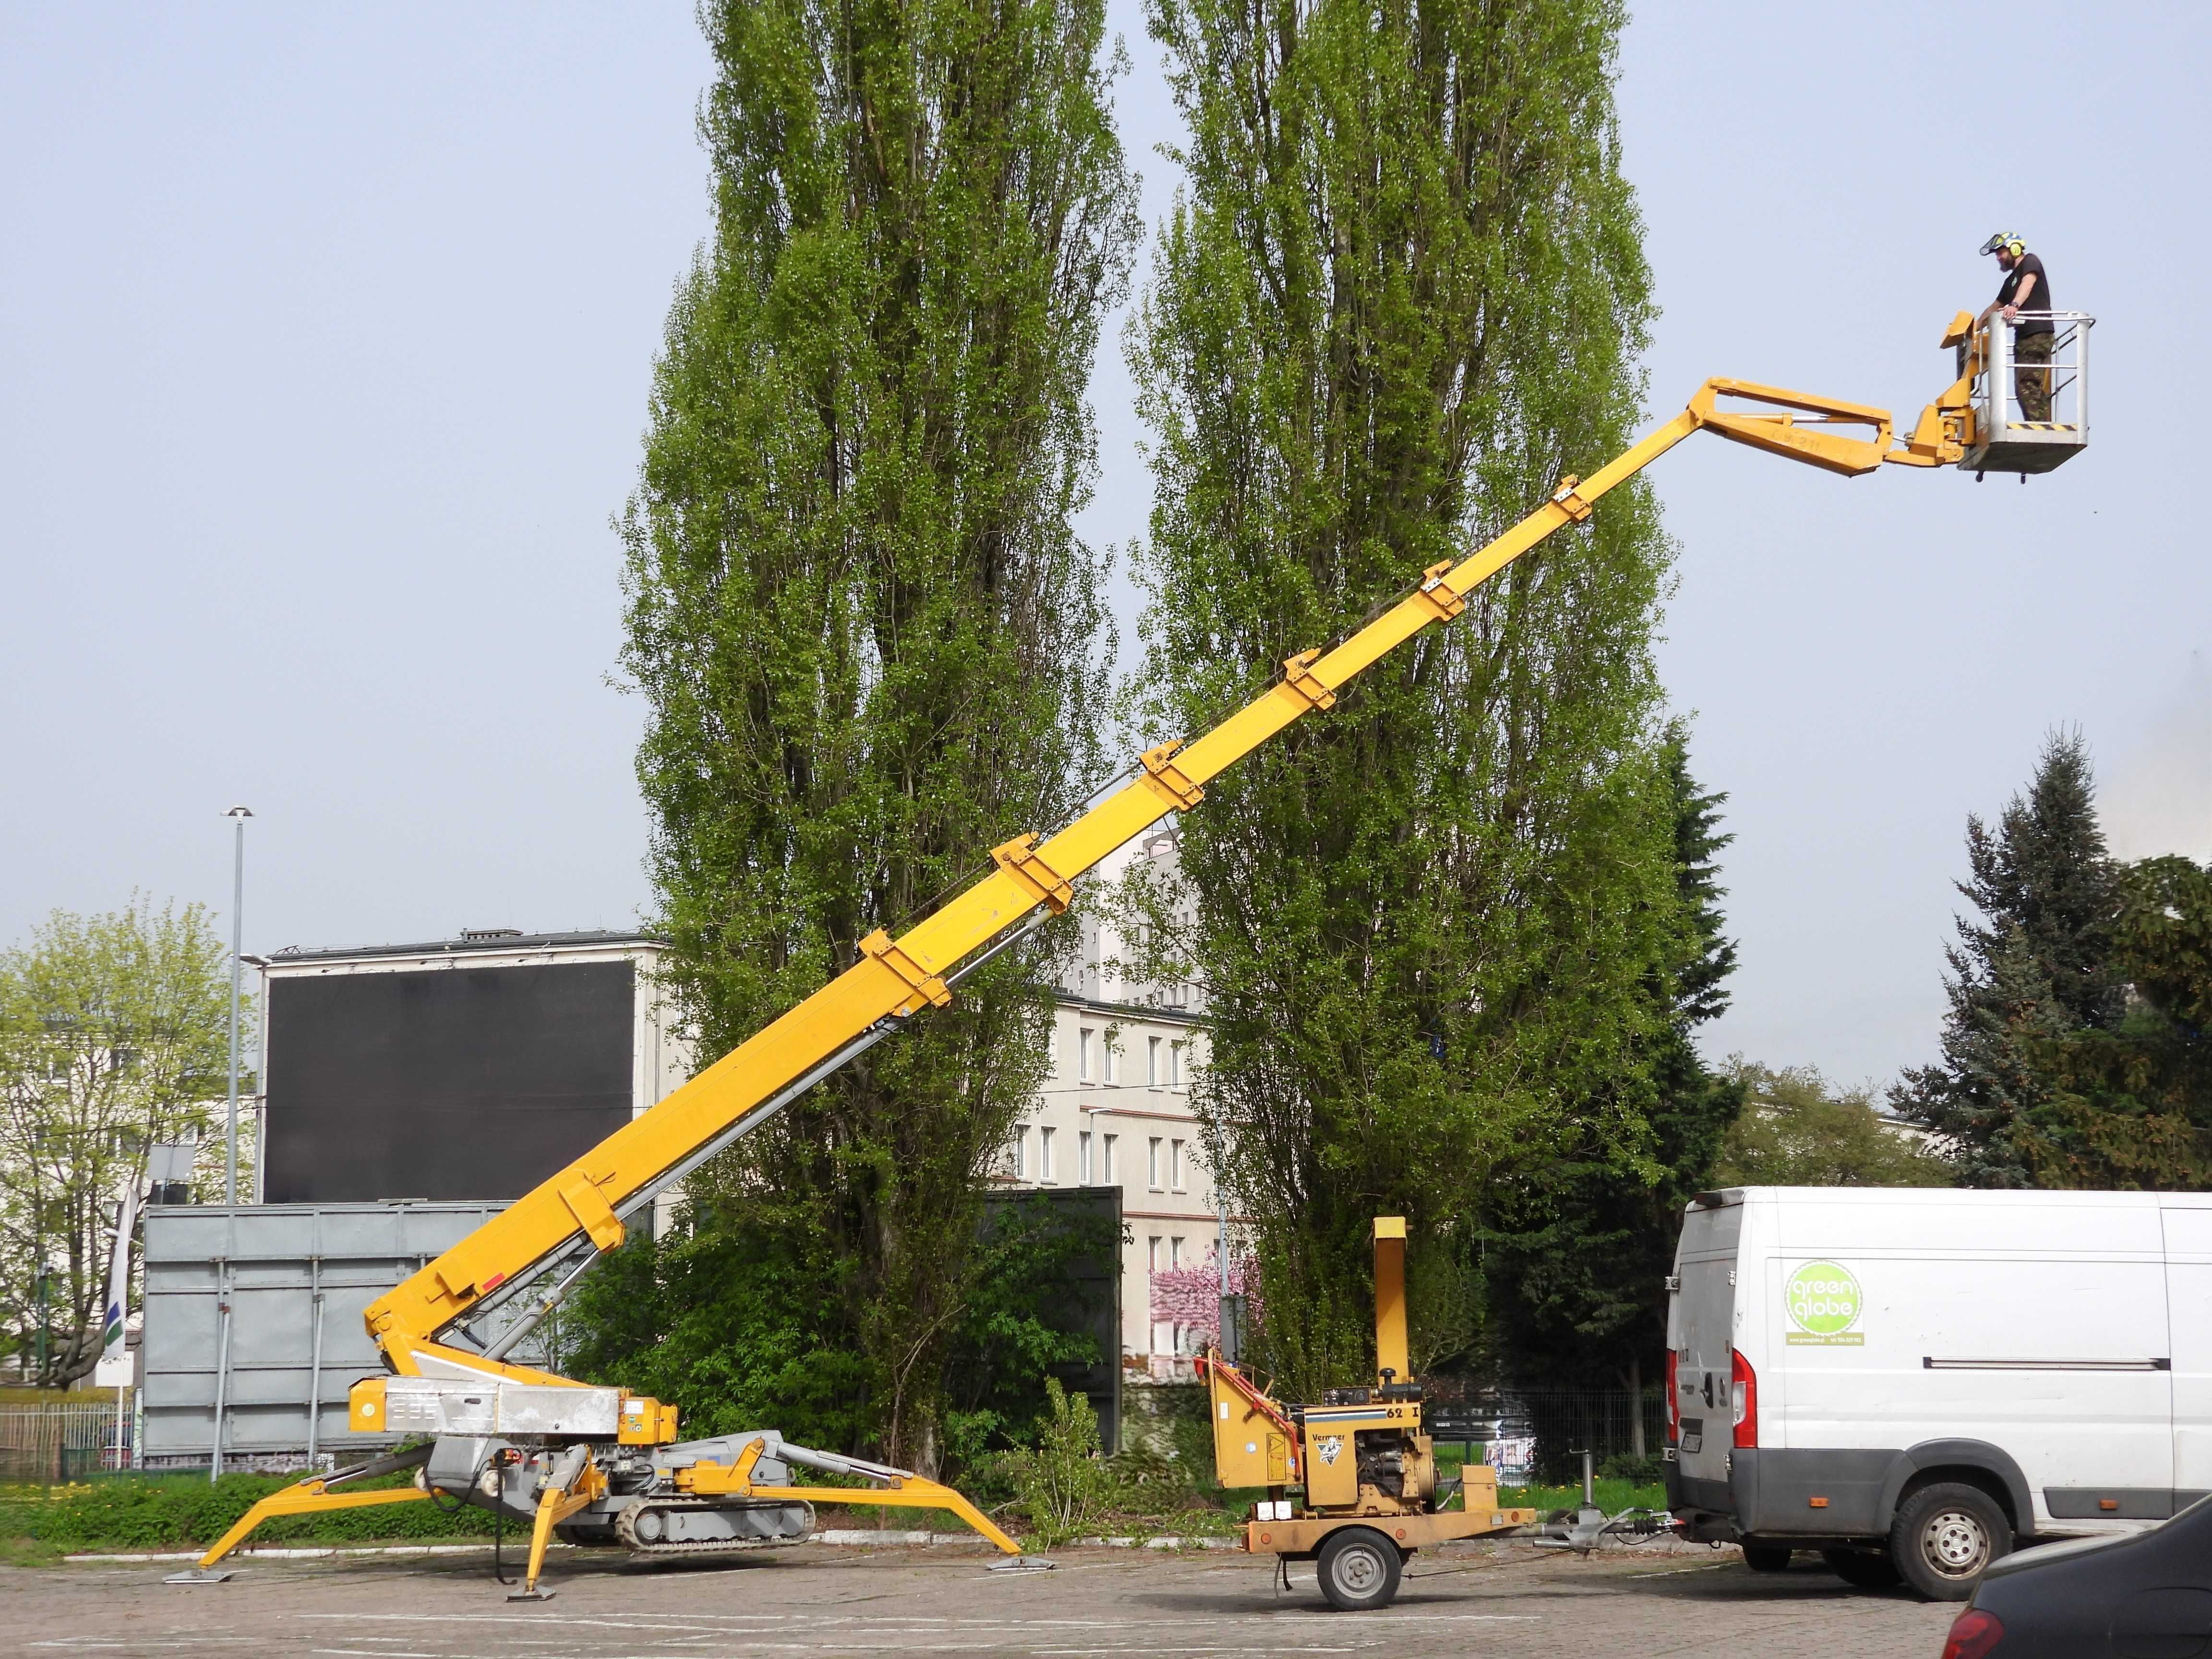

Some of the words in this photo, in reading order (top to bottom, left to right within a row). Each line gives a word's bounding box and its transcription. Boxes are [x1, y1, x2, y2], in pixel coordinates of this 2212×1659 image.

[1792, 1280, 1853, 1299] green
[1794, 1297, 1853, 1321] globe
[1387, 1407, 1403, 1419] 62
